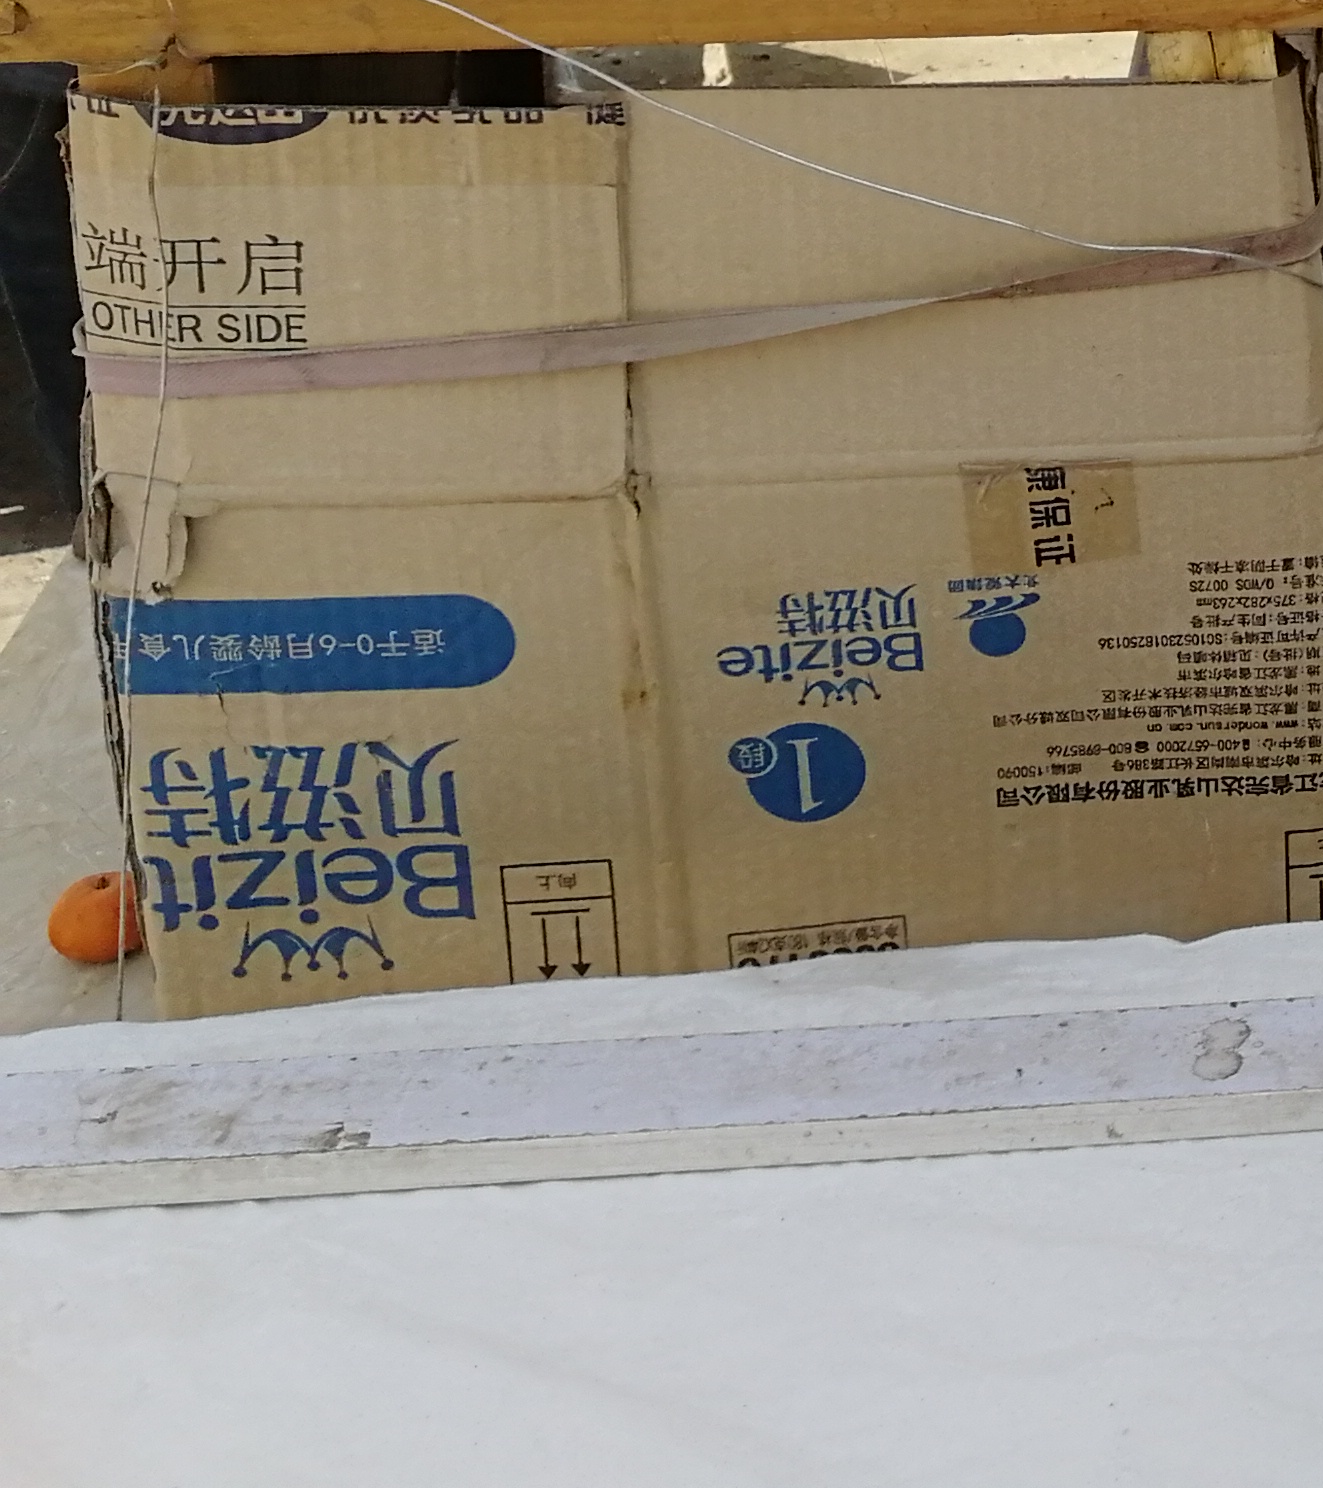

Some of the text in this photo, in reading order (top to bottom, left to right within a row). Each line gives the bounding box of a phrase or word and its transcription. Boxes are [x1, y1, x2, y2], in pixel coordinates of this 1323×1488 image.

[81, 220, 305, 297] 端开启
[92, 300, 308, 345] OTHER SIDE
[776, 583, 918, 638] 贝滋特
[715, 632, 925, 684] Beizite
[139, 738, 461, 848] 贝滋特
[142, 845, 477, 933] Beizit
[535, 873, 577, 892] 向上
